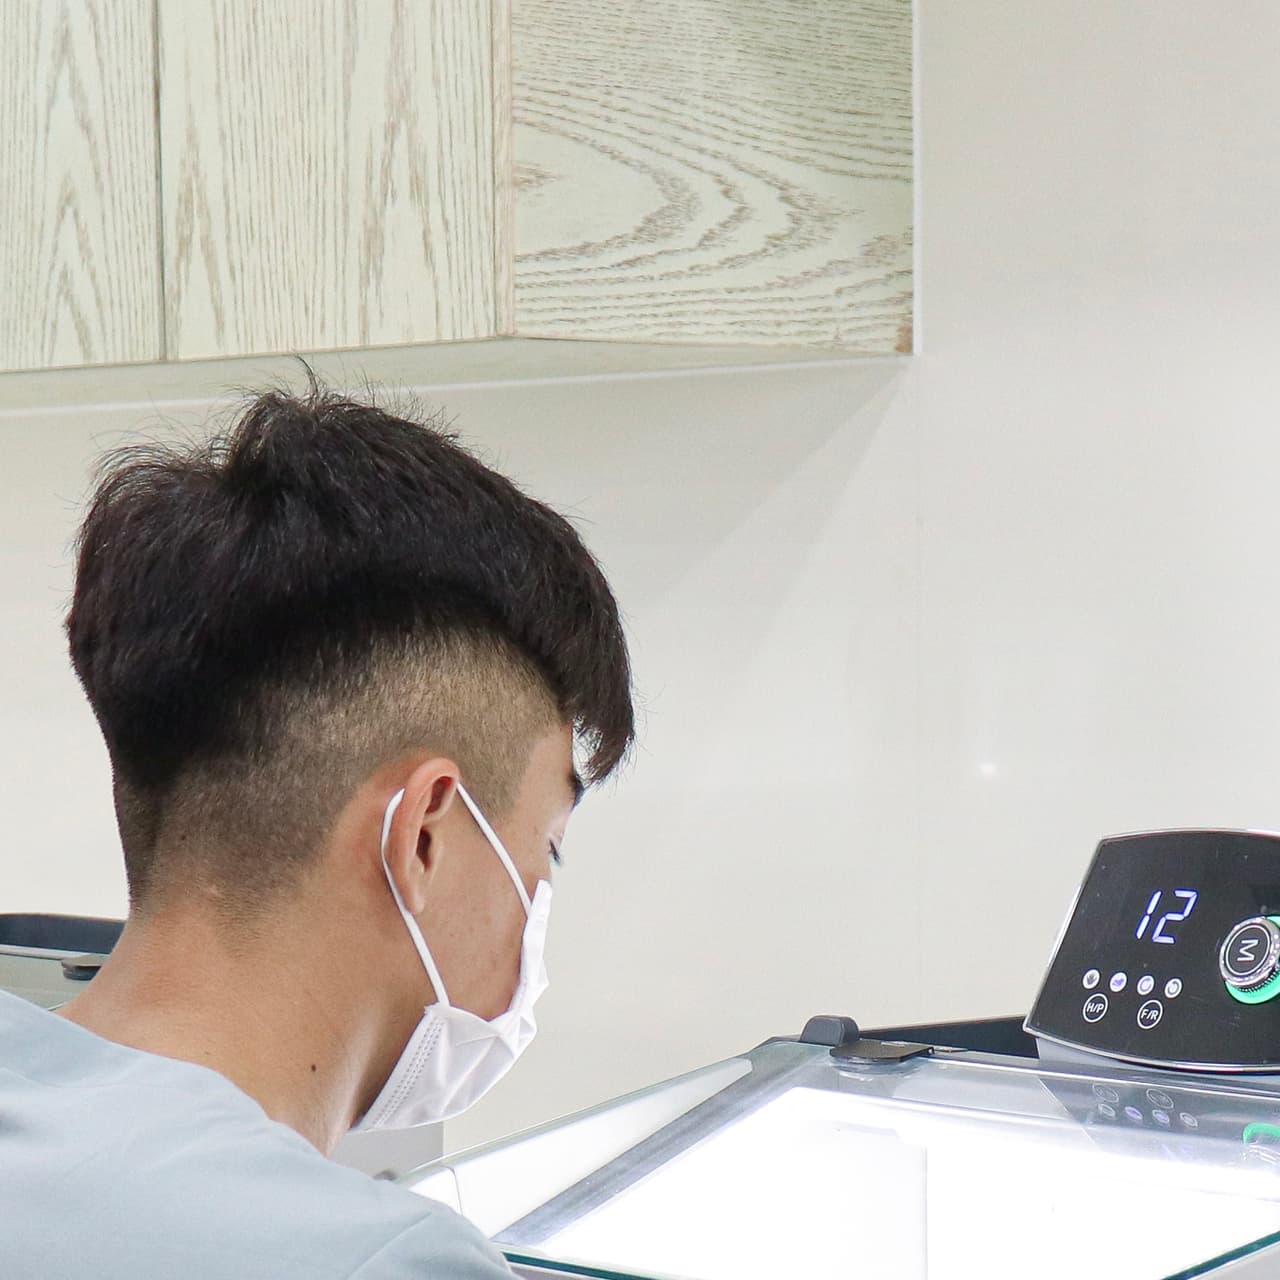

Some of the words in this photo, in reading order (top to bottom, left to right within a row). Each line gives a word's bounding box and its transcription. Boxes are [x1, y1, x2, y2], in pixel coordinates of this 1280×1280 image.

[1136, 888, 1197, 944] 12
[1237, 938, 1259, 961] M
[1086, 1001, 1105, 1013] H/P
[1140, 1009, 1160, 1020] F/R
